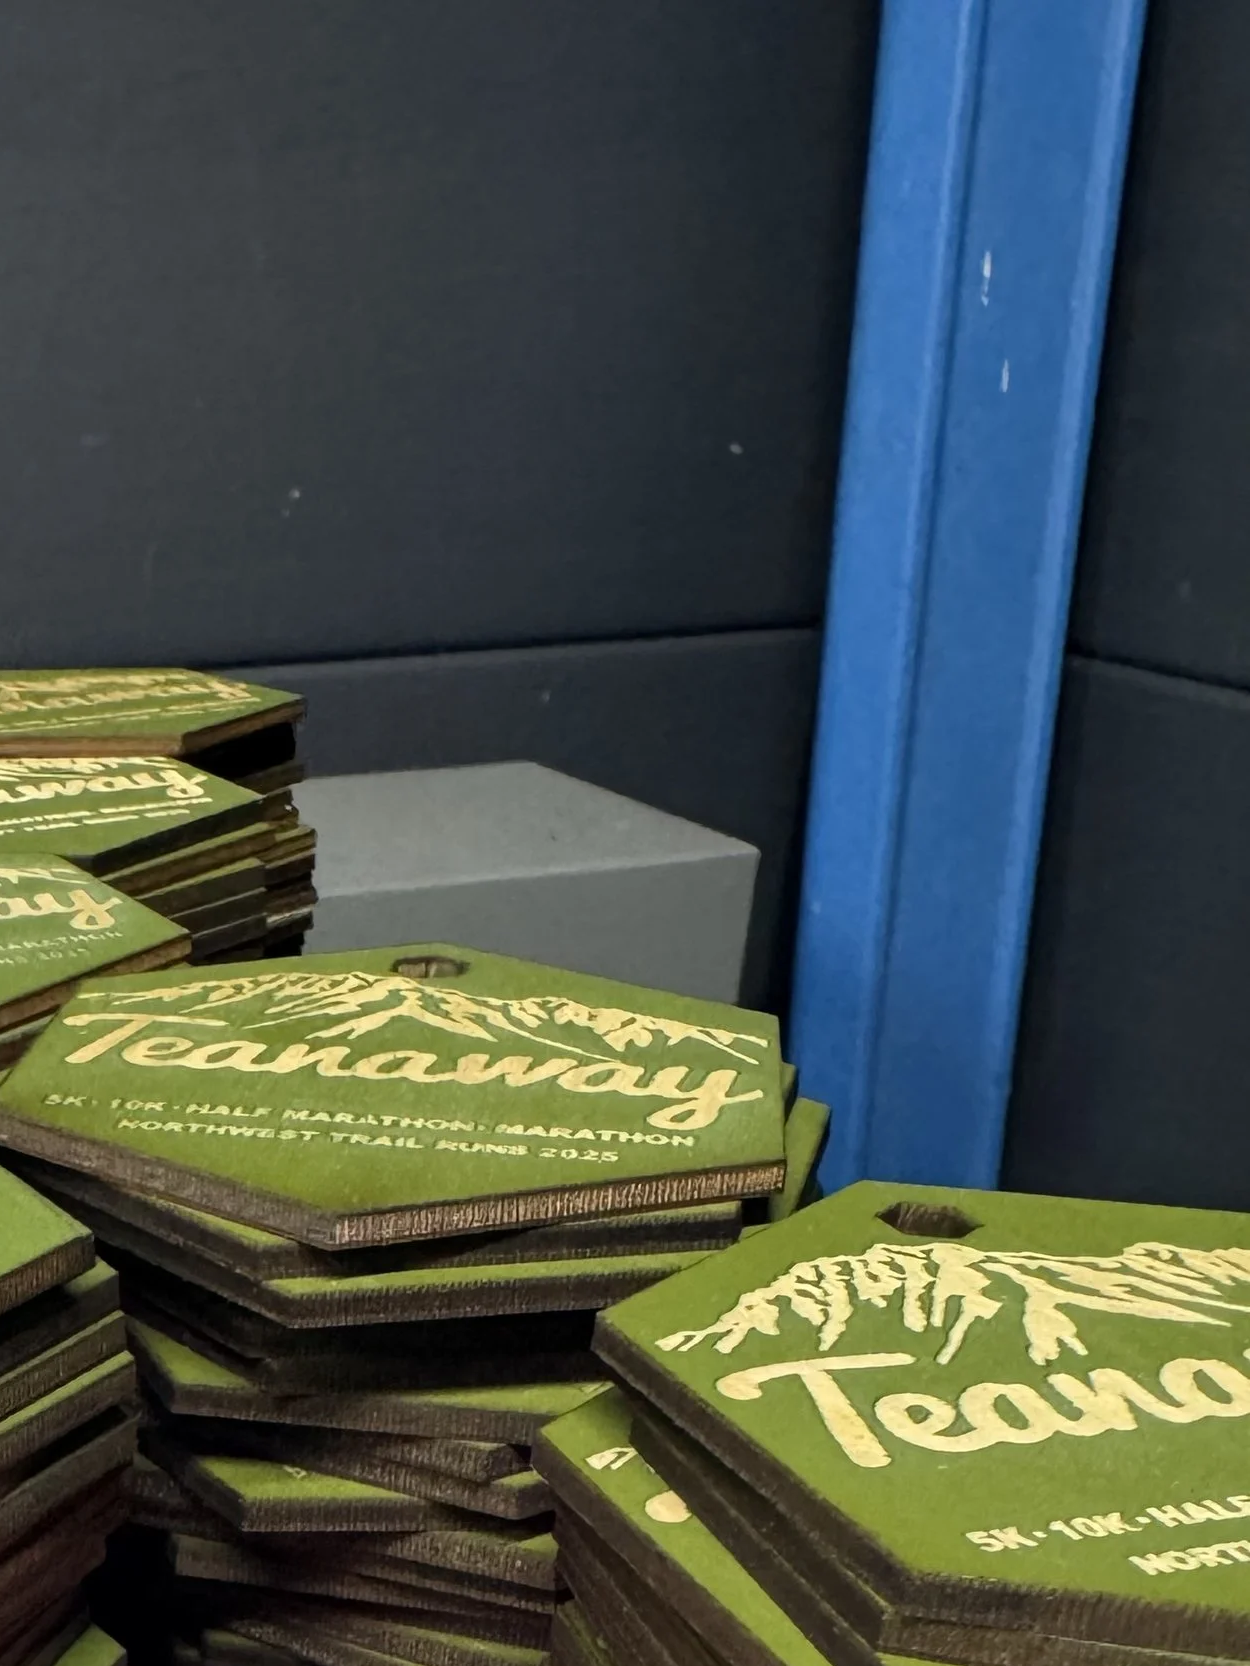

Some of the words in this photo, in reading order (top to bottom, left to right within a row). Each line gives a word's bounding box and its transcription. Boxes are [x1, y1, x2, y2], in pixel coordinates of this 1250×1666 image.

[63, 1012, 764, 1131] Teanaway
[110, 1098, 167, 1112] 10K
[186, 1102, 273, 1118] HALF
[282, 1108, 477, 1132] MARATHON
[494, 1123, 695, 1147] MARATHON
[117, 1119, 321, 1142] NORTHWEST
[330, 1131, 425, 1150] TRAIL
[435, 1139, 529, 1156] RUNS
[538, 1147, 620, 1164] 2025
[715, 1347, 1250, 1468] Teana
[965, 1526, 1039, 1552] 5K
[1049, 1512, 1143, 1541] 10K
